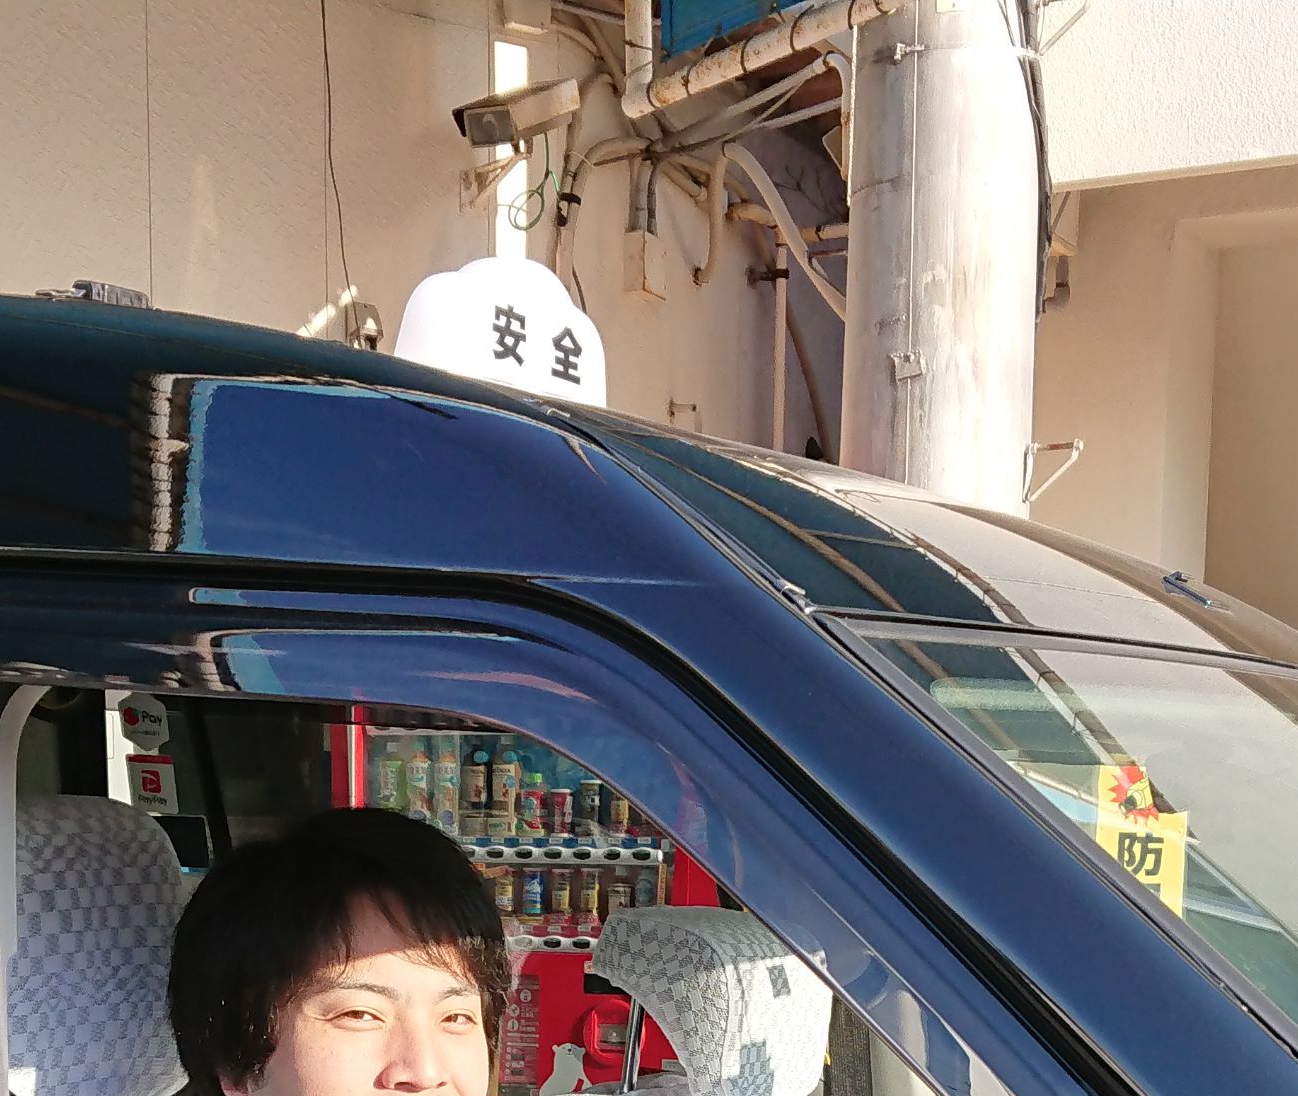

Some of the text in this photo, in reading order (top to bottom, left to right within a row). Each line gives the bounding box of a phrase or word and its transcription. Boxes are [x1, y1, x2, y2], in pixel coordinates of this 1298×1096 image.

[492, 304, 583, 386] 安全
[141, 711, 162, 726] Pay
[1117, 832, 1164, 898] 防
